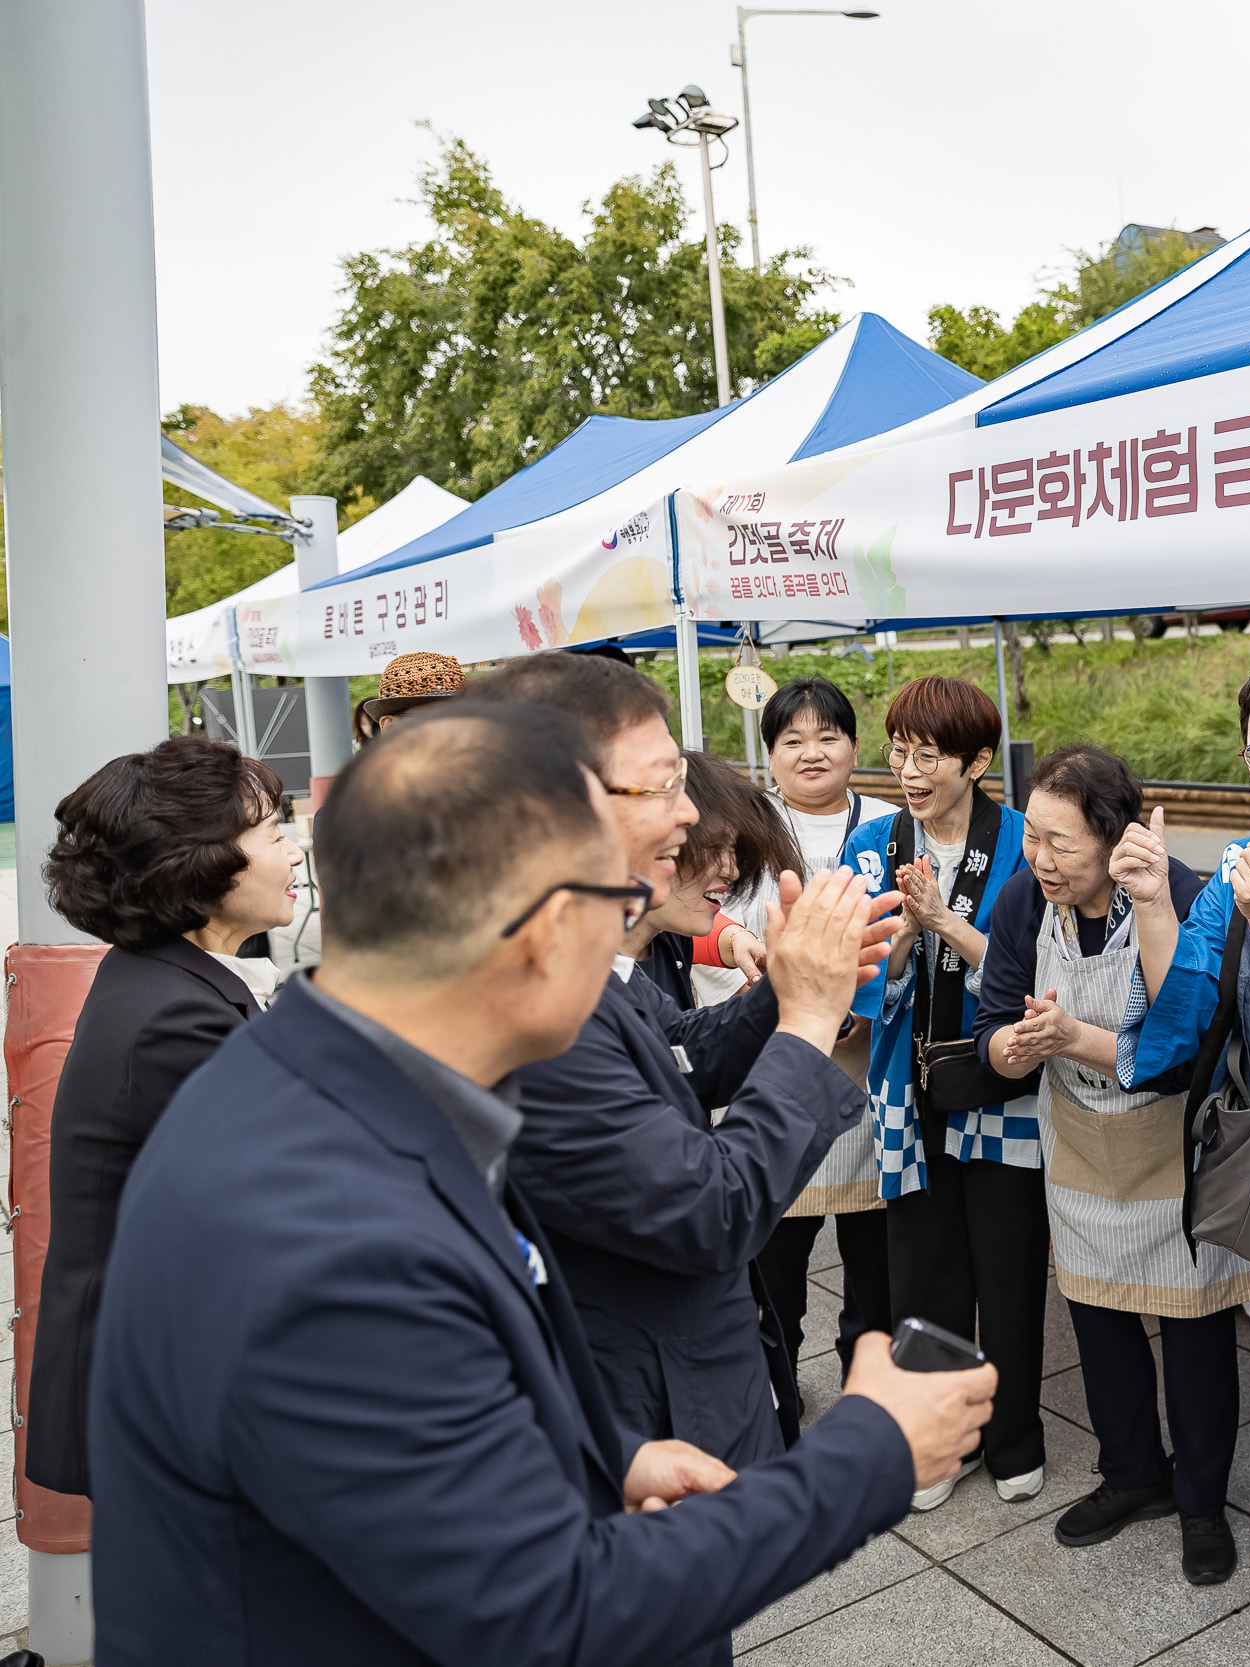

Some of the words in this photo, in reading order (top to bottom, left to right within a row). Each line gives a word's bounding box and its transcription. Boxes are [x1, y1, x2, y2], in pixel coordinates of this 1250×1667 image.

[719, 492, 766, 515] 제11회
[946, 424, 1199, 540] 다문화체험
[788, 518, 846, 561] 축제
[730, 576, 754, 599] 꿈을
[782, 573, 821, 598] 중곡을
[821, 572, 850, 596] 잇다
[325, 599, 364, 639] 올바른
[376, 579, 448, 632] 구강관리
